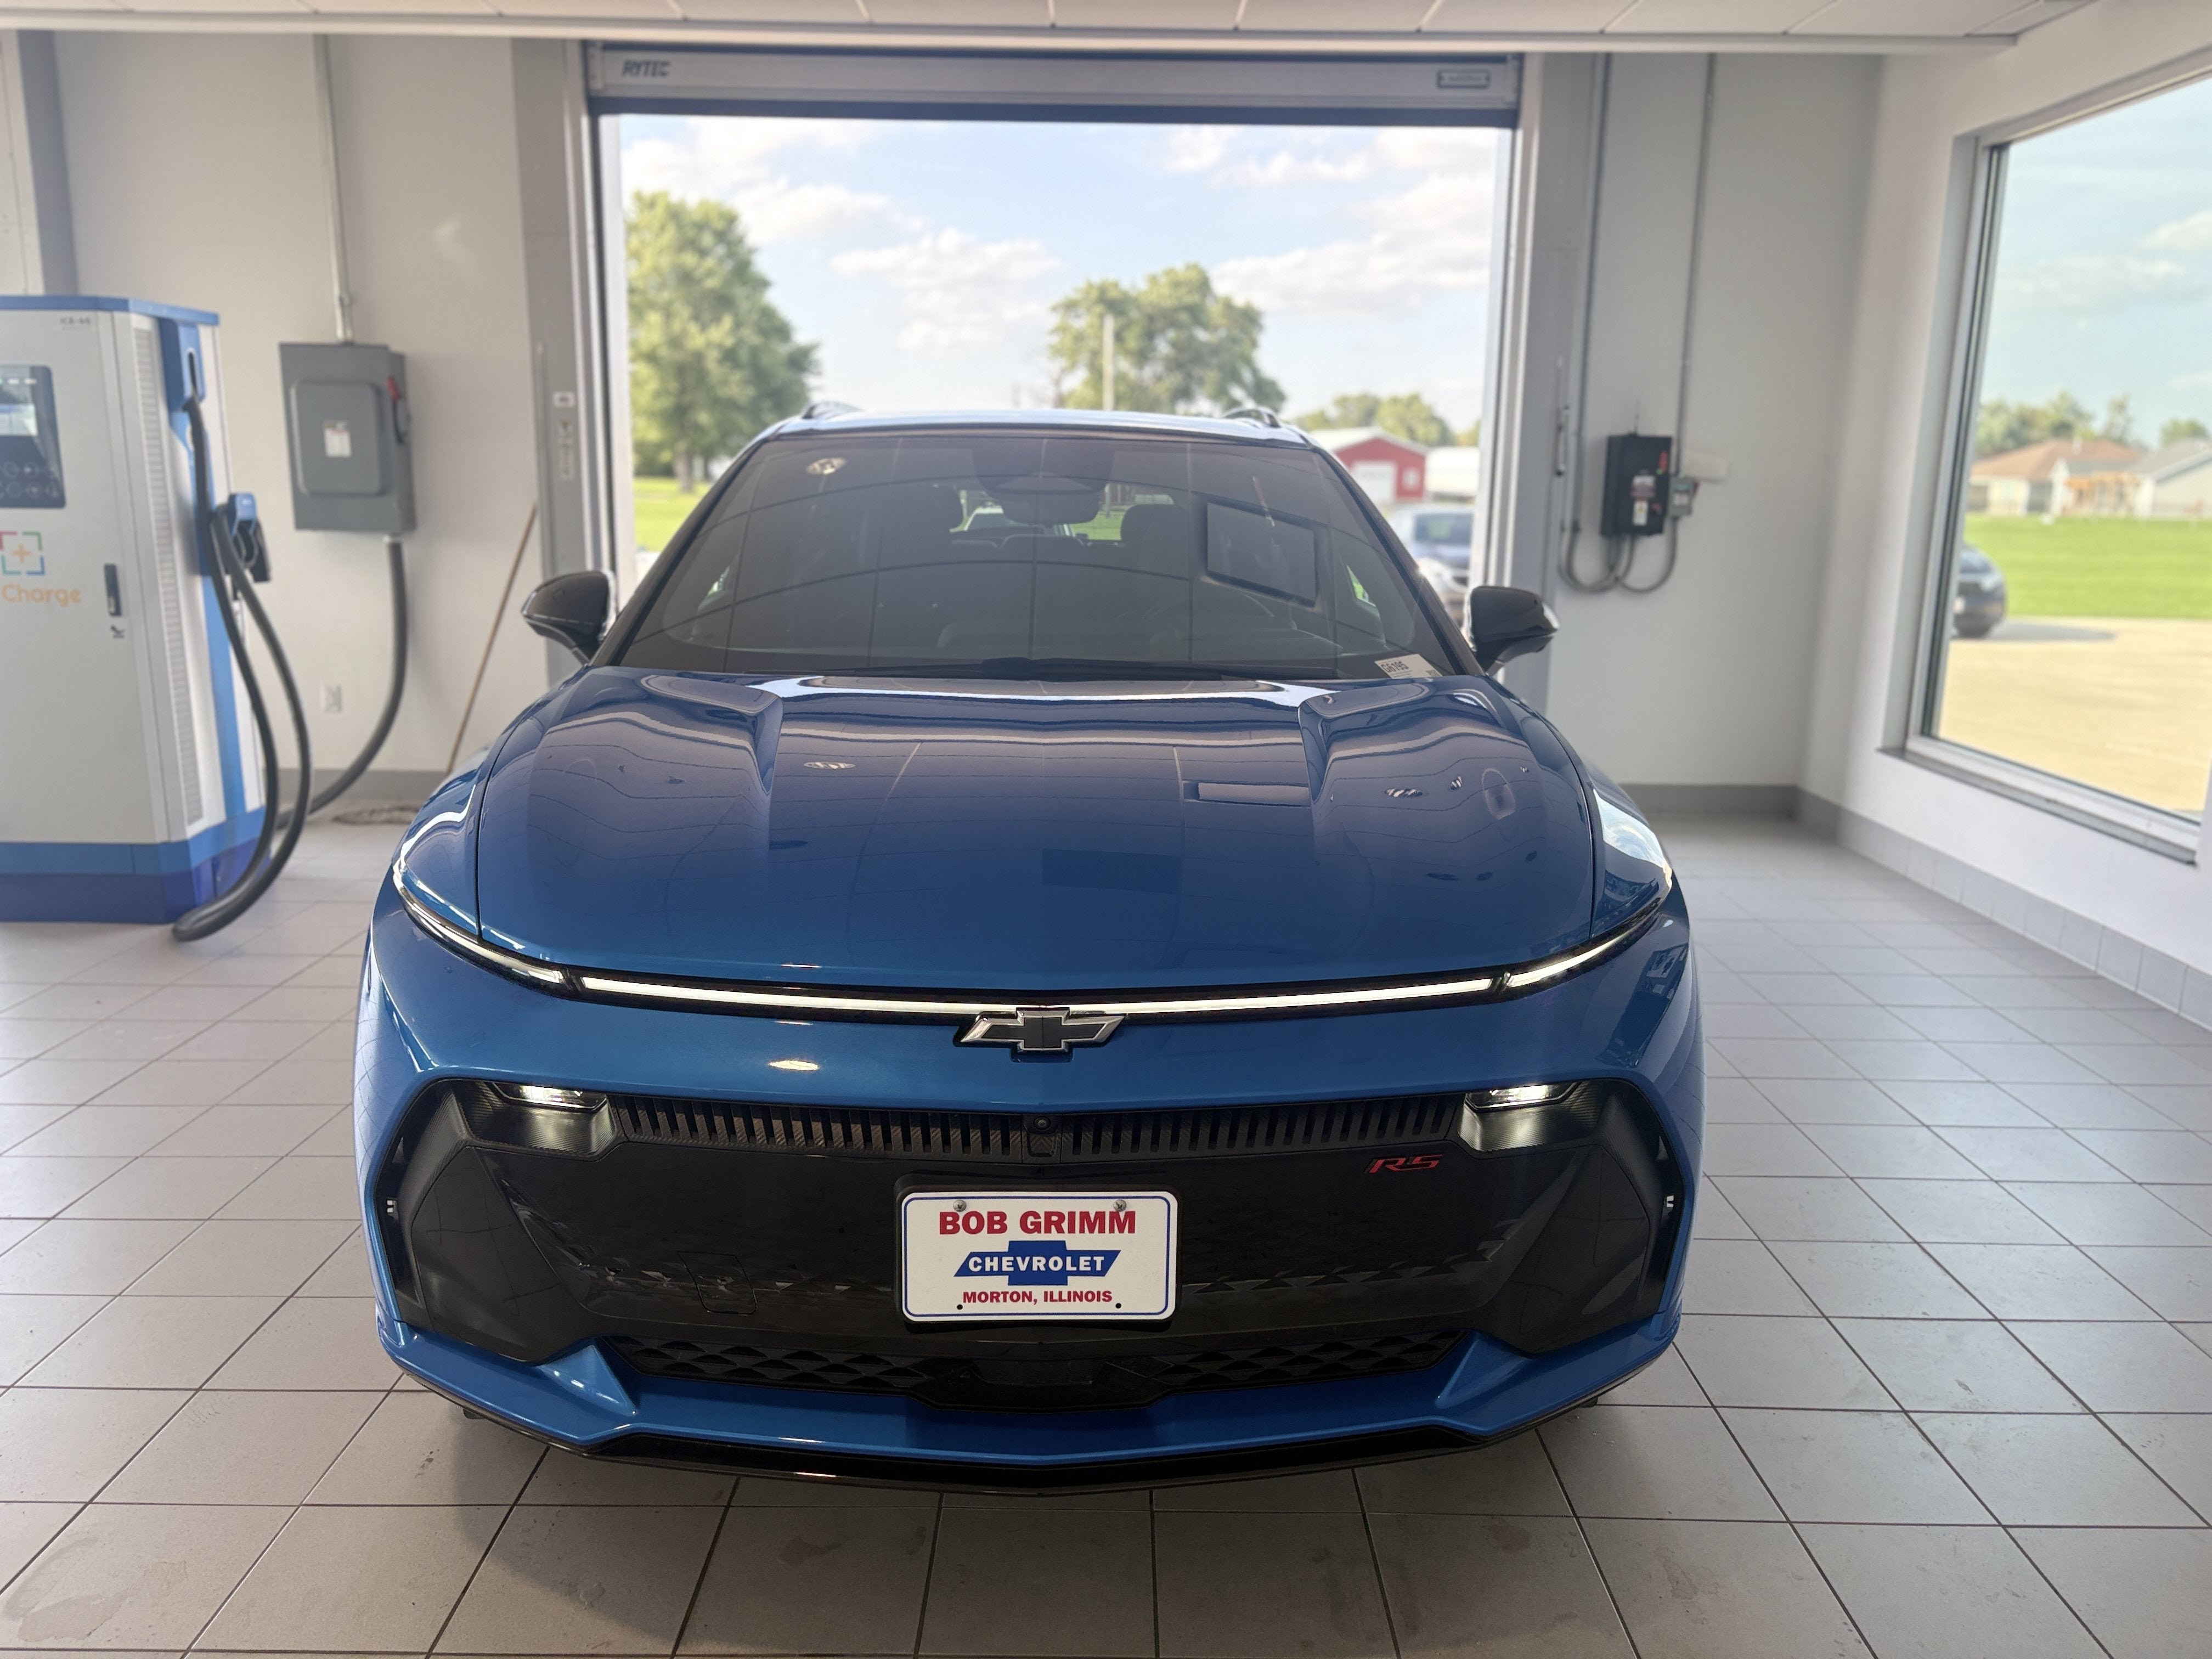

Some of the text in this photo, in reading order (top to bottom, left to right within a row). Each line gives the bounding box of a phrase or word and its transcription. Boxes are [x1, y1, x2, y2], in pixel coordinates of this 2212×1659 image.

[621, 59, 672, 77] RYTEC
[2, 584, 82, 607] Charge
[1380, 661, 1409, 673] G6195
[1363, 1153, 1446, 1174] RS
[939, 1210, 1136, 1235] BOB GRIMM
[968, 1255, 1105, 1272] CHEVROLET
[962, 1290, 1113, 1305] MORTON, ILLINOIS
